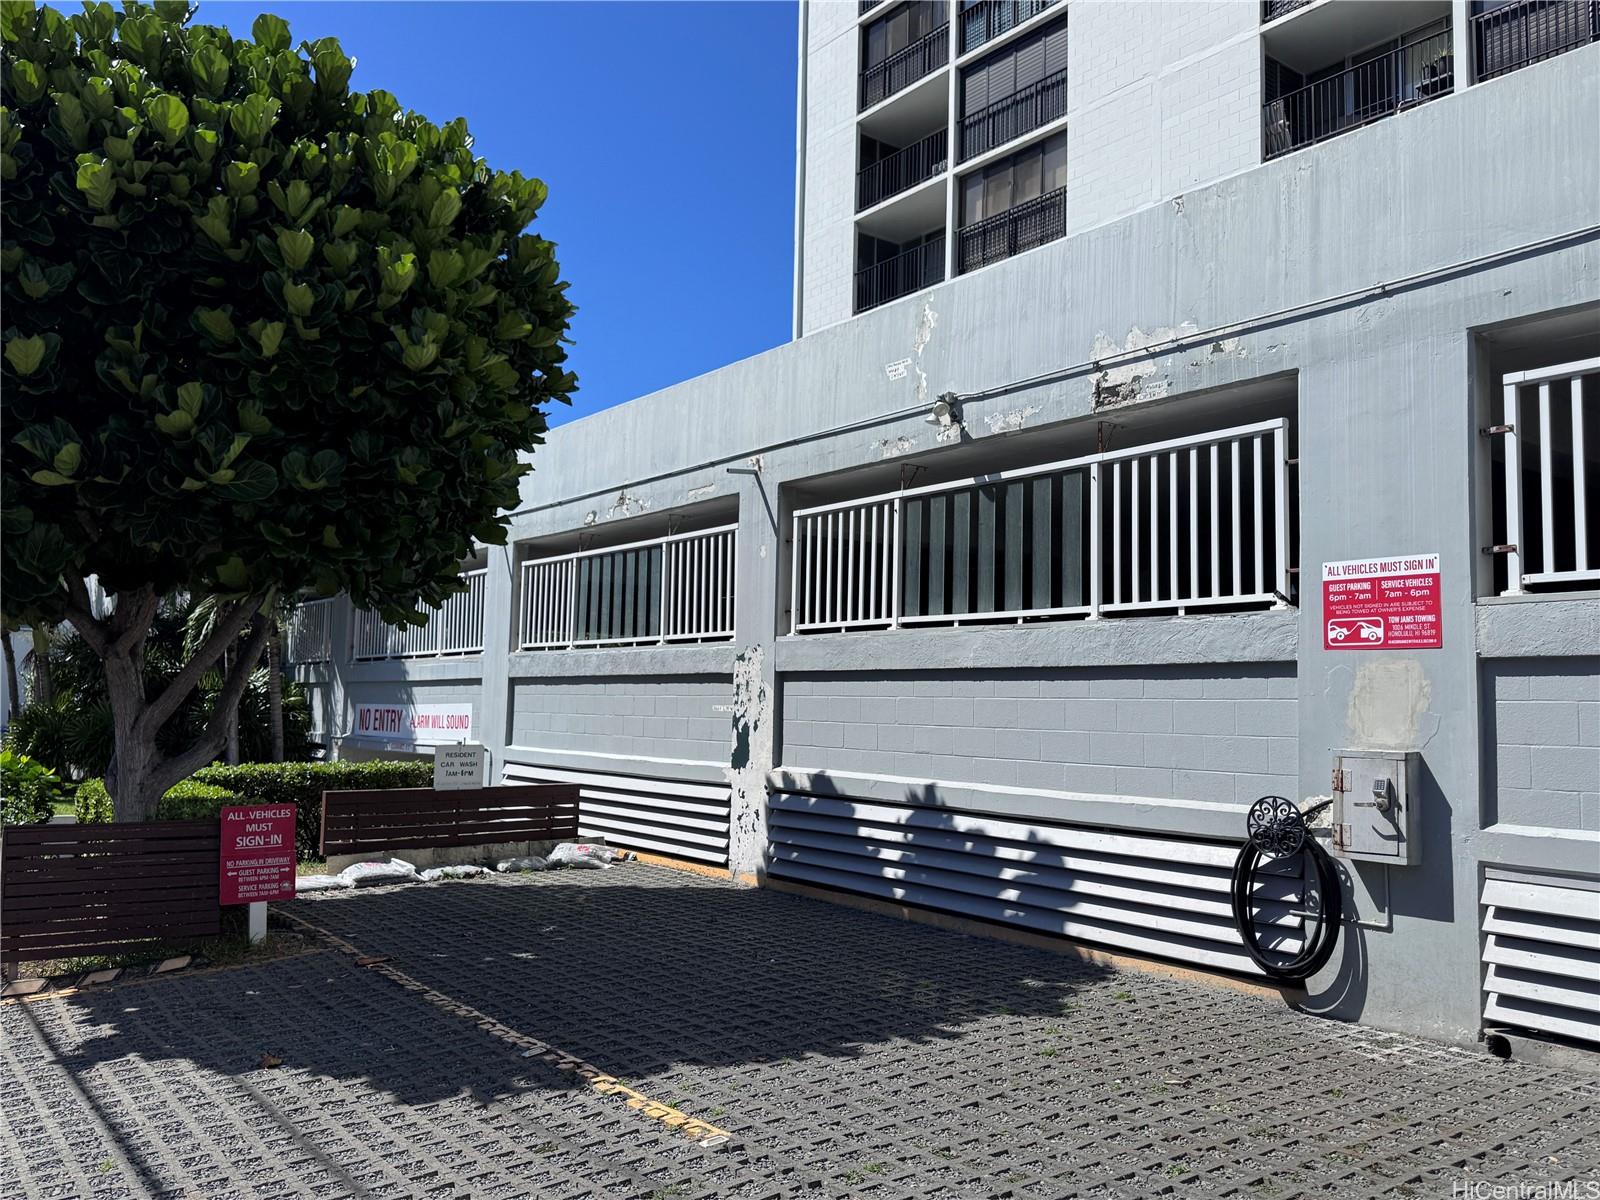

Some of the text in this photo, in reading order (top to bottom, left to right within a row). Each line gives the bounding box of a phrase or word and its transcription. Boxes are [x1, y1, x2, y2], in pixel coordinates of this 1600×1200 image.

[1327, 558, 1434, 576] ALL VEHICLES MUST SIGN IN
[1328, 582, 1371, 592] GUEST PARKING
[1381, 578, 1432, 589] SERVICE VEHICLES
[1329, 594, 1346, 602] 6pm
[358, 708, 404, 732] NO ENTRY
[410, 714, 469, 729] ALARM WILL SOUND
[228, 809, 291, 821] ALL VEHICLES
[246, 823, 272, 832] MUST
[236, 834, 282, 847] SIGN-IN
